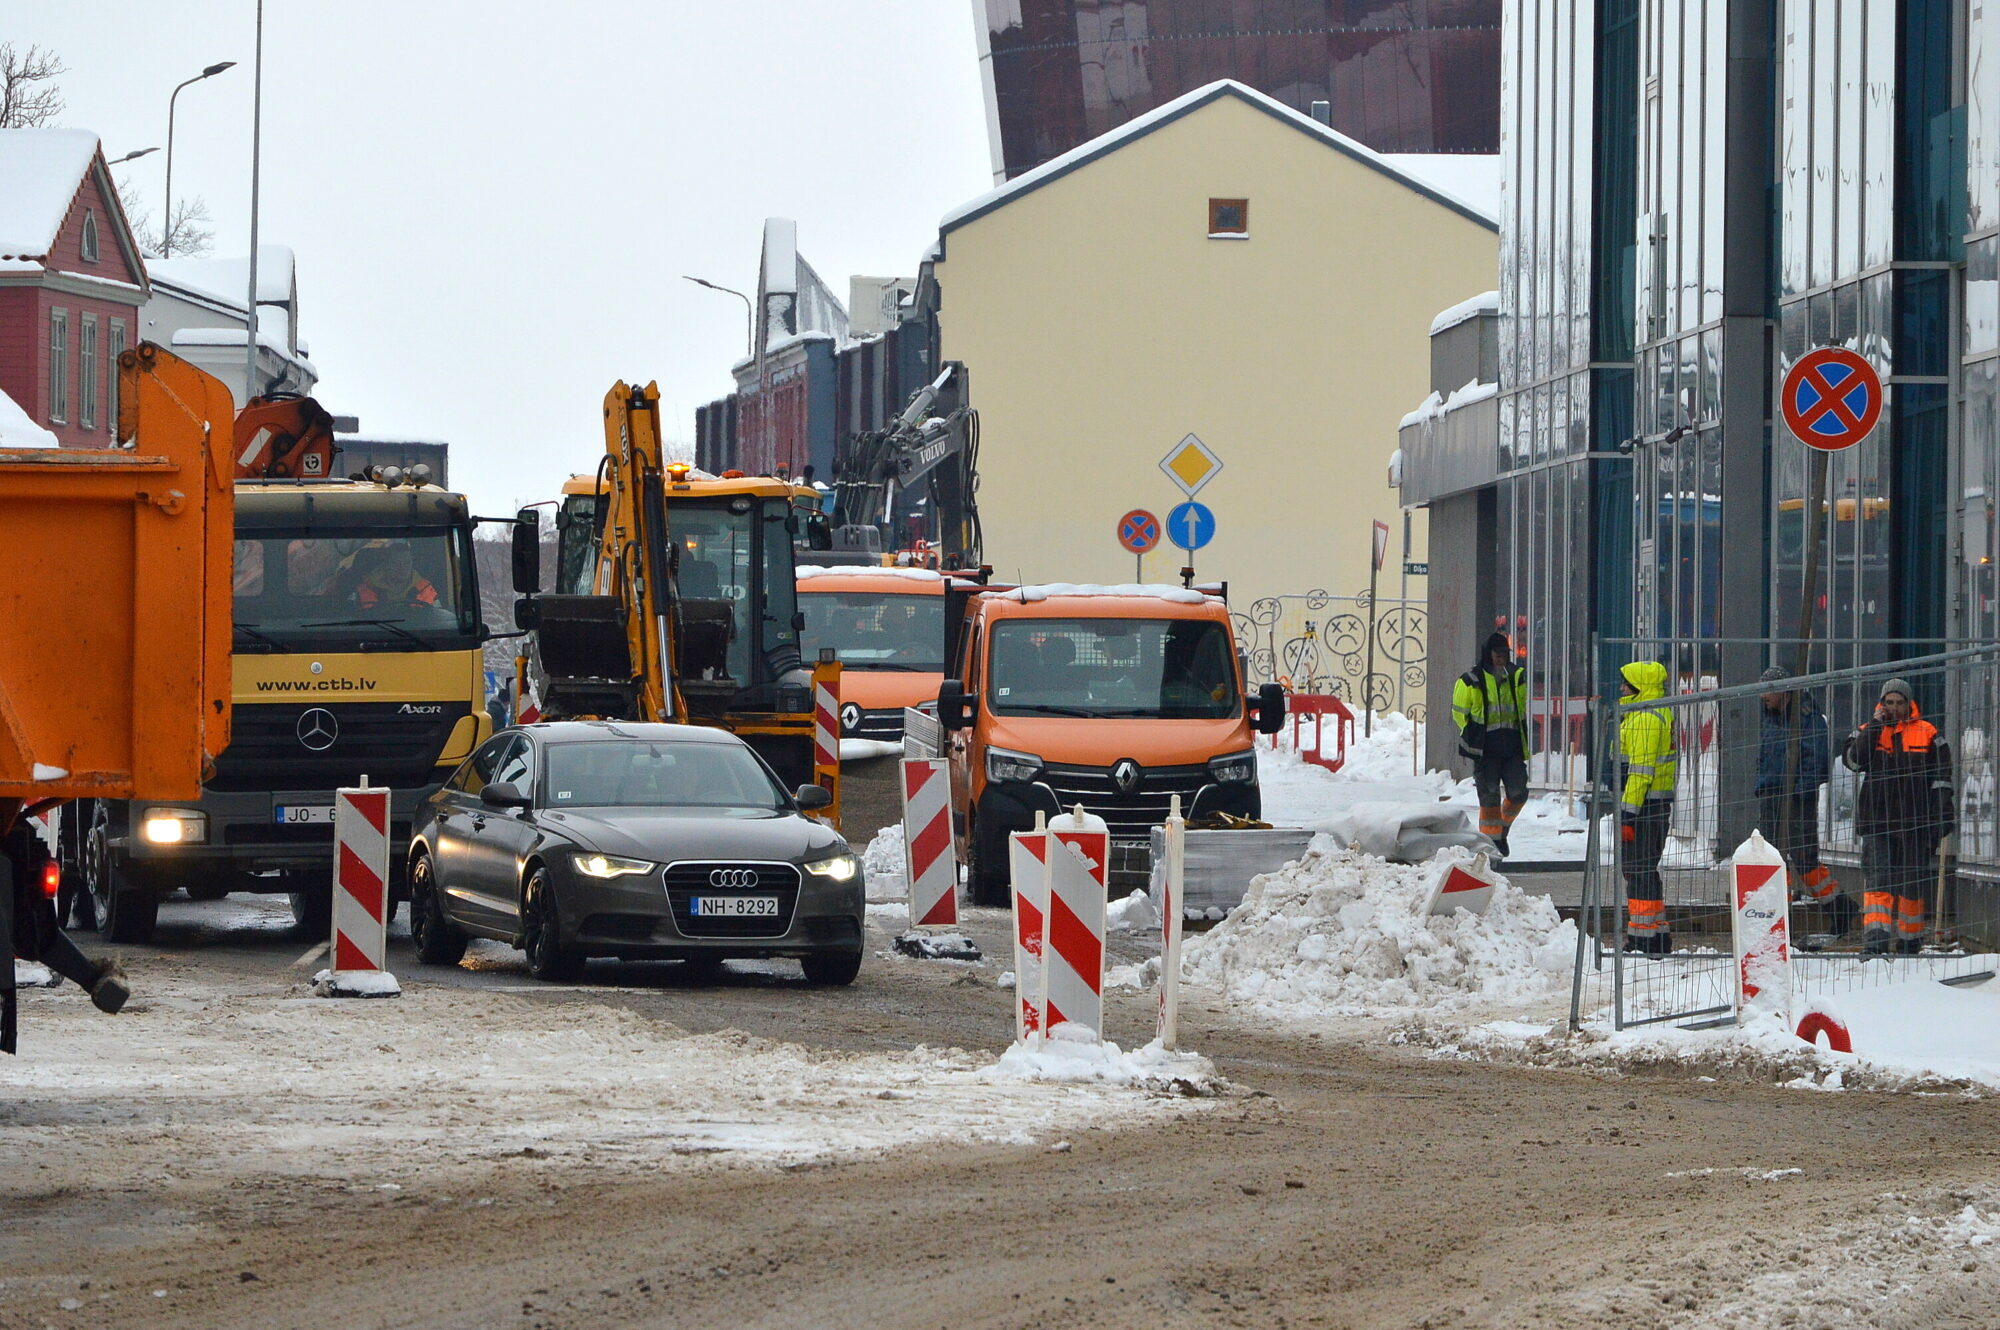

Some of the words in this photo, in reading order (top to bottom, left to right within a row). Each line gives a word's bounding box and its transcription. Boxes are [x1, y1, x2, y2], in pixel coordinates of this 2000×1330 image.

[920, 440, 946, 465] VOLVO
[256, 677, 377, 691] www.ctb.lv
[702, 899, 776, 915] NH-8292
